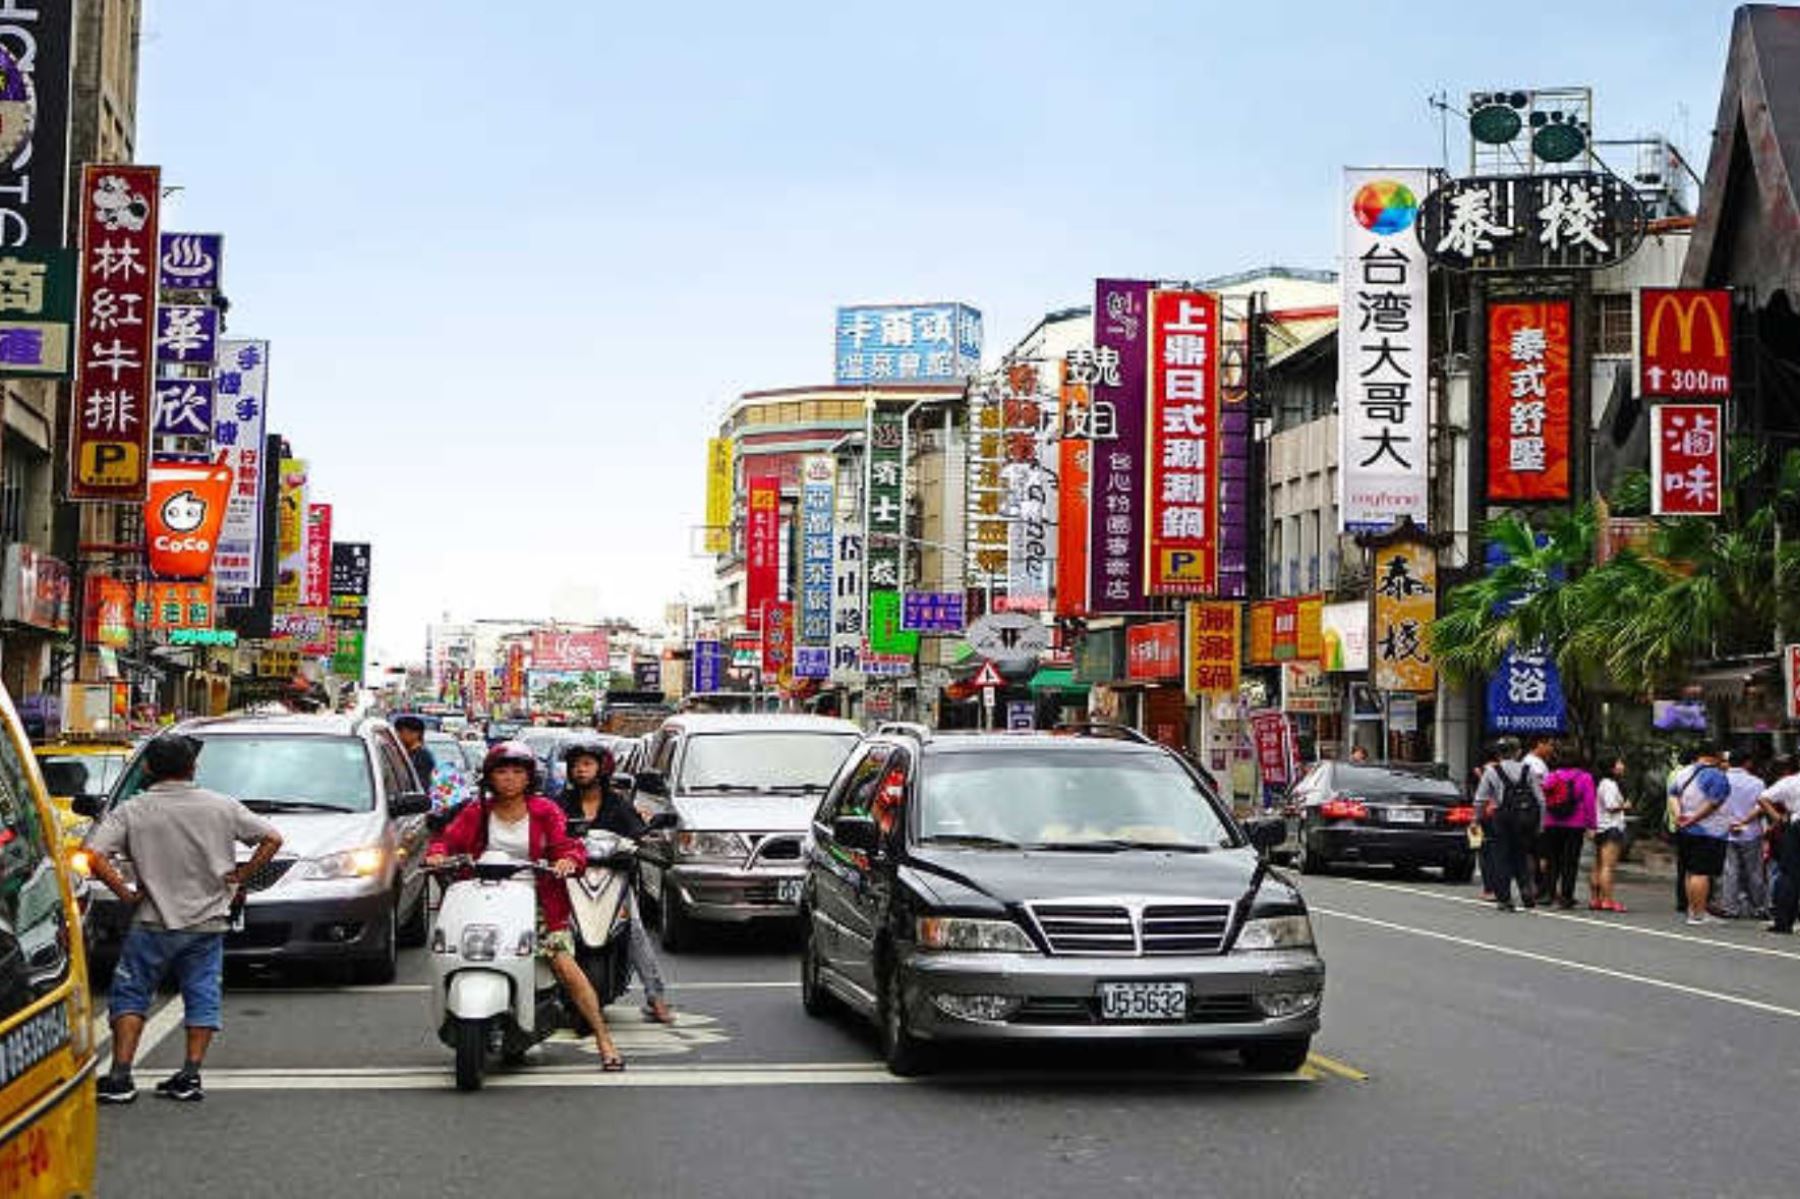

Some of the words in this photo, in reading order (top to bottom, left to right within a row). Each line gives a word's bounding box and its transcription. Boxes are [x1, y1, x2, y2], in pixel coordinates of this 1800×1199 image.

[1436, 184, 1609, 257] 泰棧
[85, 237, 147, 434] 林紅牛排
[1065, 346, 1124, 439] 魏姐
[1162, 300, 1207, 538] 上鼎日式涮涮鍋
[1510, 327, 1547, 471] 泰式舒壓
[1671, 370, 1728, 390] 300m
[94, 445, 126, 474] P
[1665, 414, 1715, 506] 滷味
[154, 535, 210, 554] CoCo
[1171, 551, 1196, 573] P
